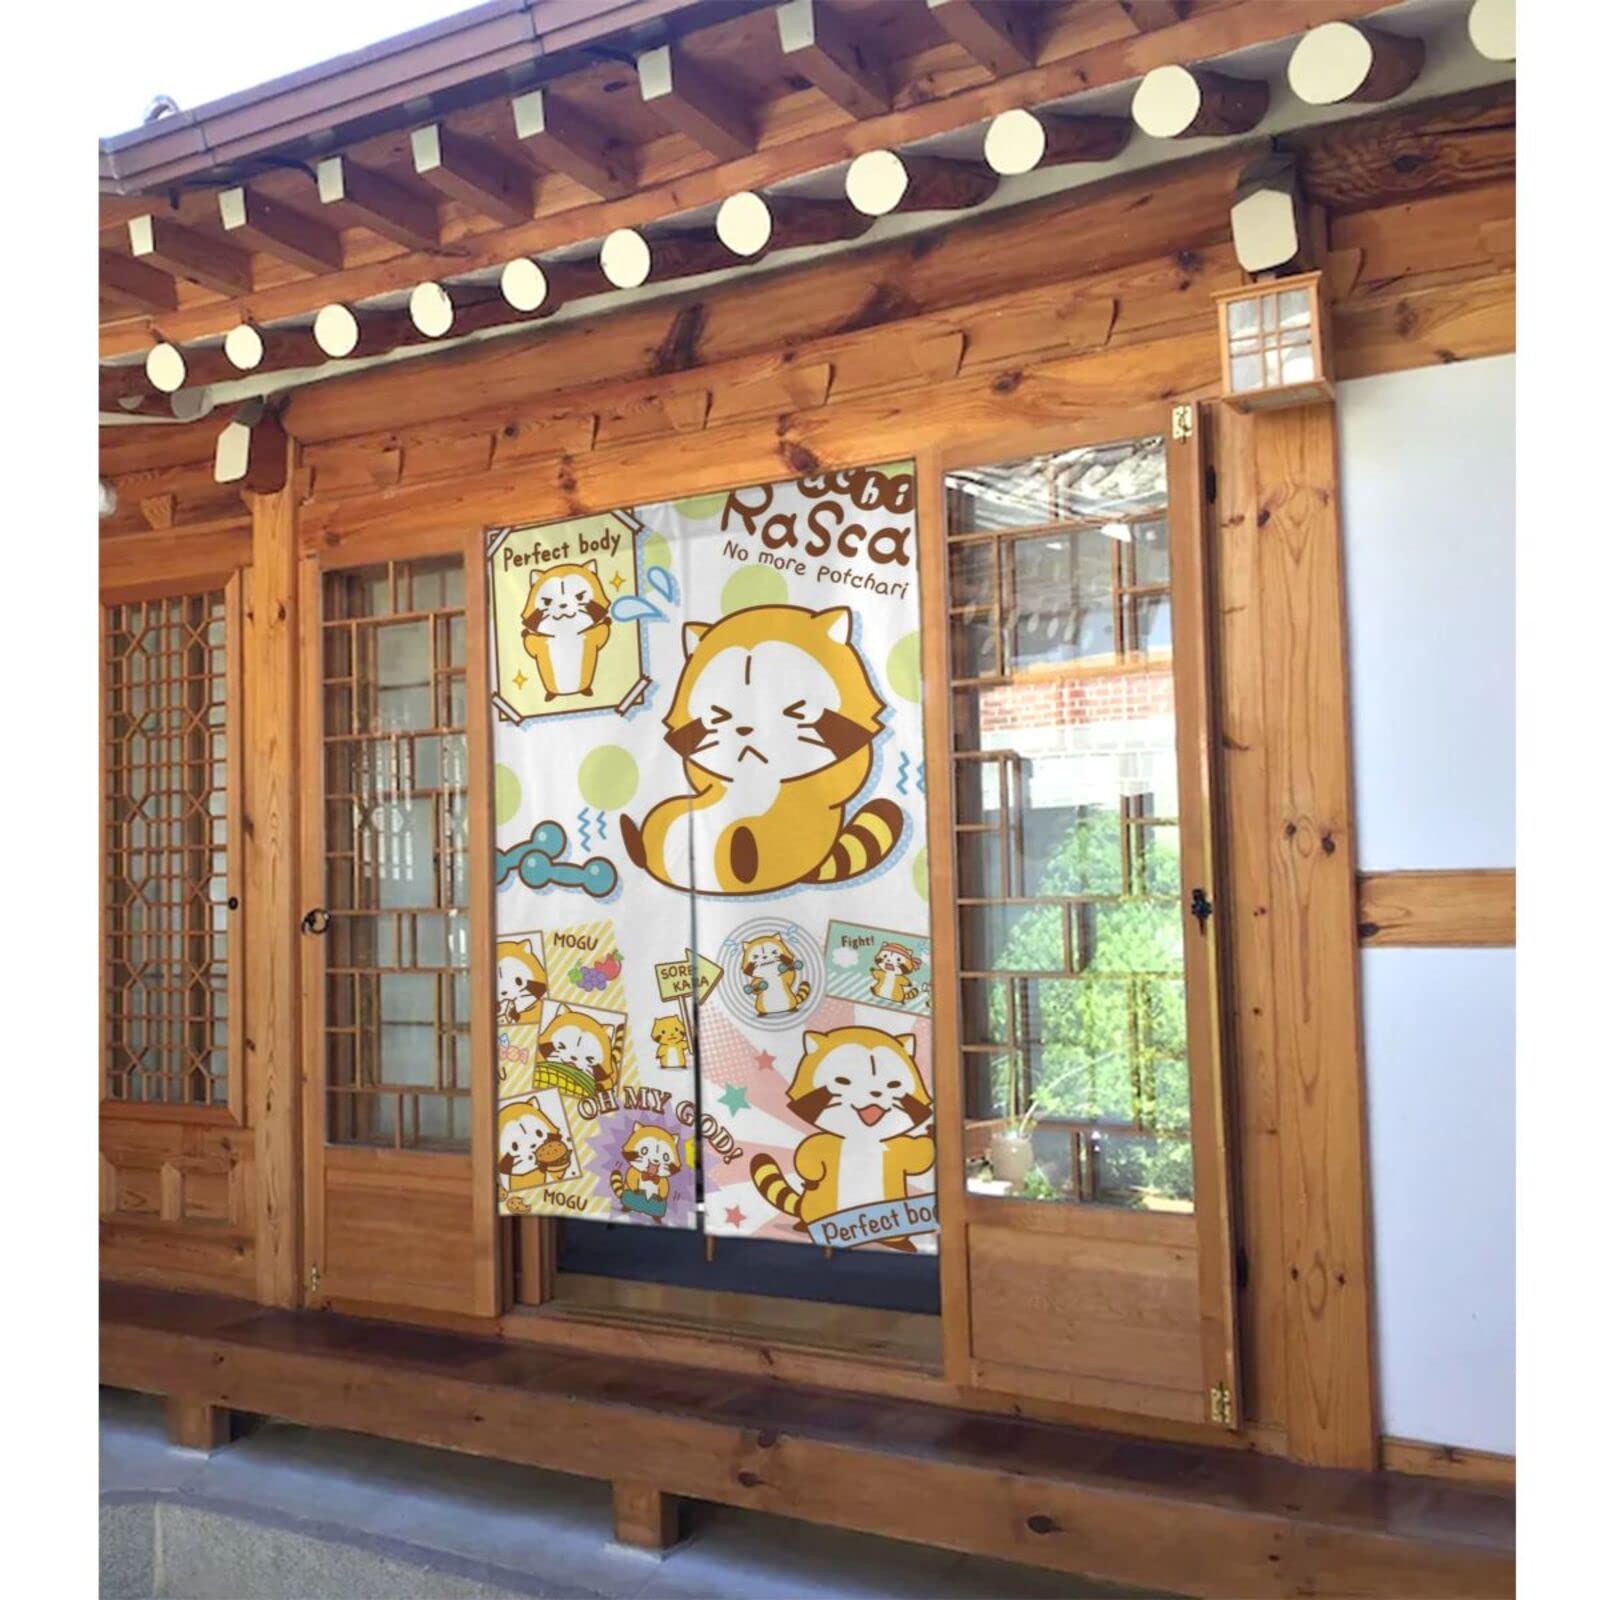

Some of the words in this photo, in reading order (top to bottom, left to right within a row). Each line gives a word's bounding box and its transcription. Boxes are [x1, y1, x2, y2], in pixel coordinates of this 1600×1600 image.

[503, 542, 570, 572] Perfect
[578, 528, 621, 558] body
[722, 540, 749, 561] No
[758, 551, 806, 576] more
[553, 932, 598, 951] MOGU
[841, 935, 875, 949] Fight!
[660, 965, 695, 980] SORE
[577, 1089, 620, 1120] OH
[623, 1086, 672, 1115] MY
[675, 1100, 744, 1165] GOD!
[543, 1189, 588, 1211] MOGU
[821, 1210, 900, 1244] Perfect
